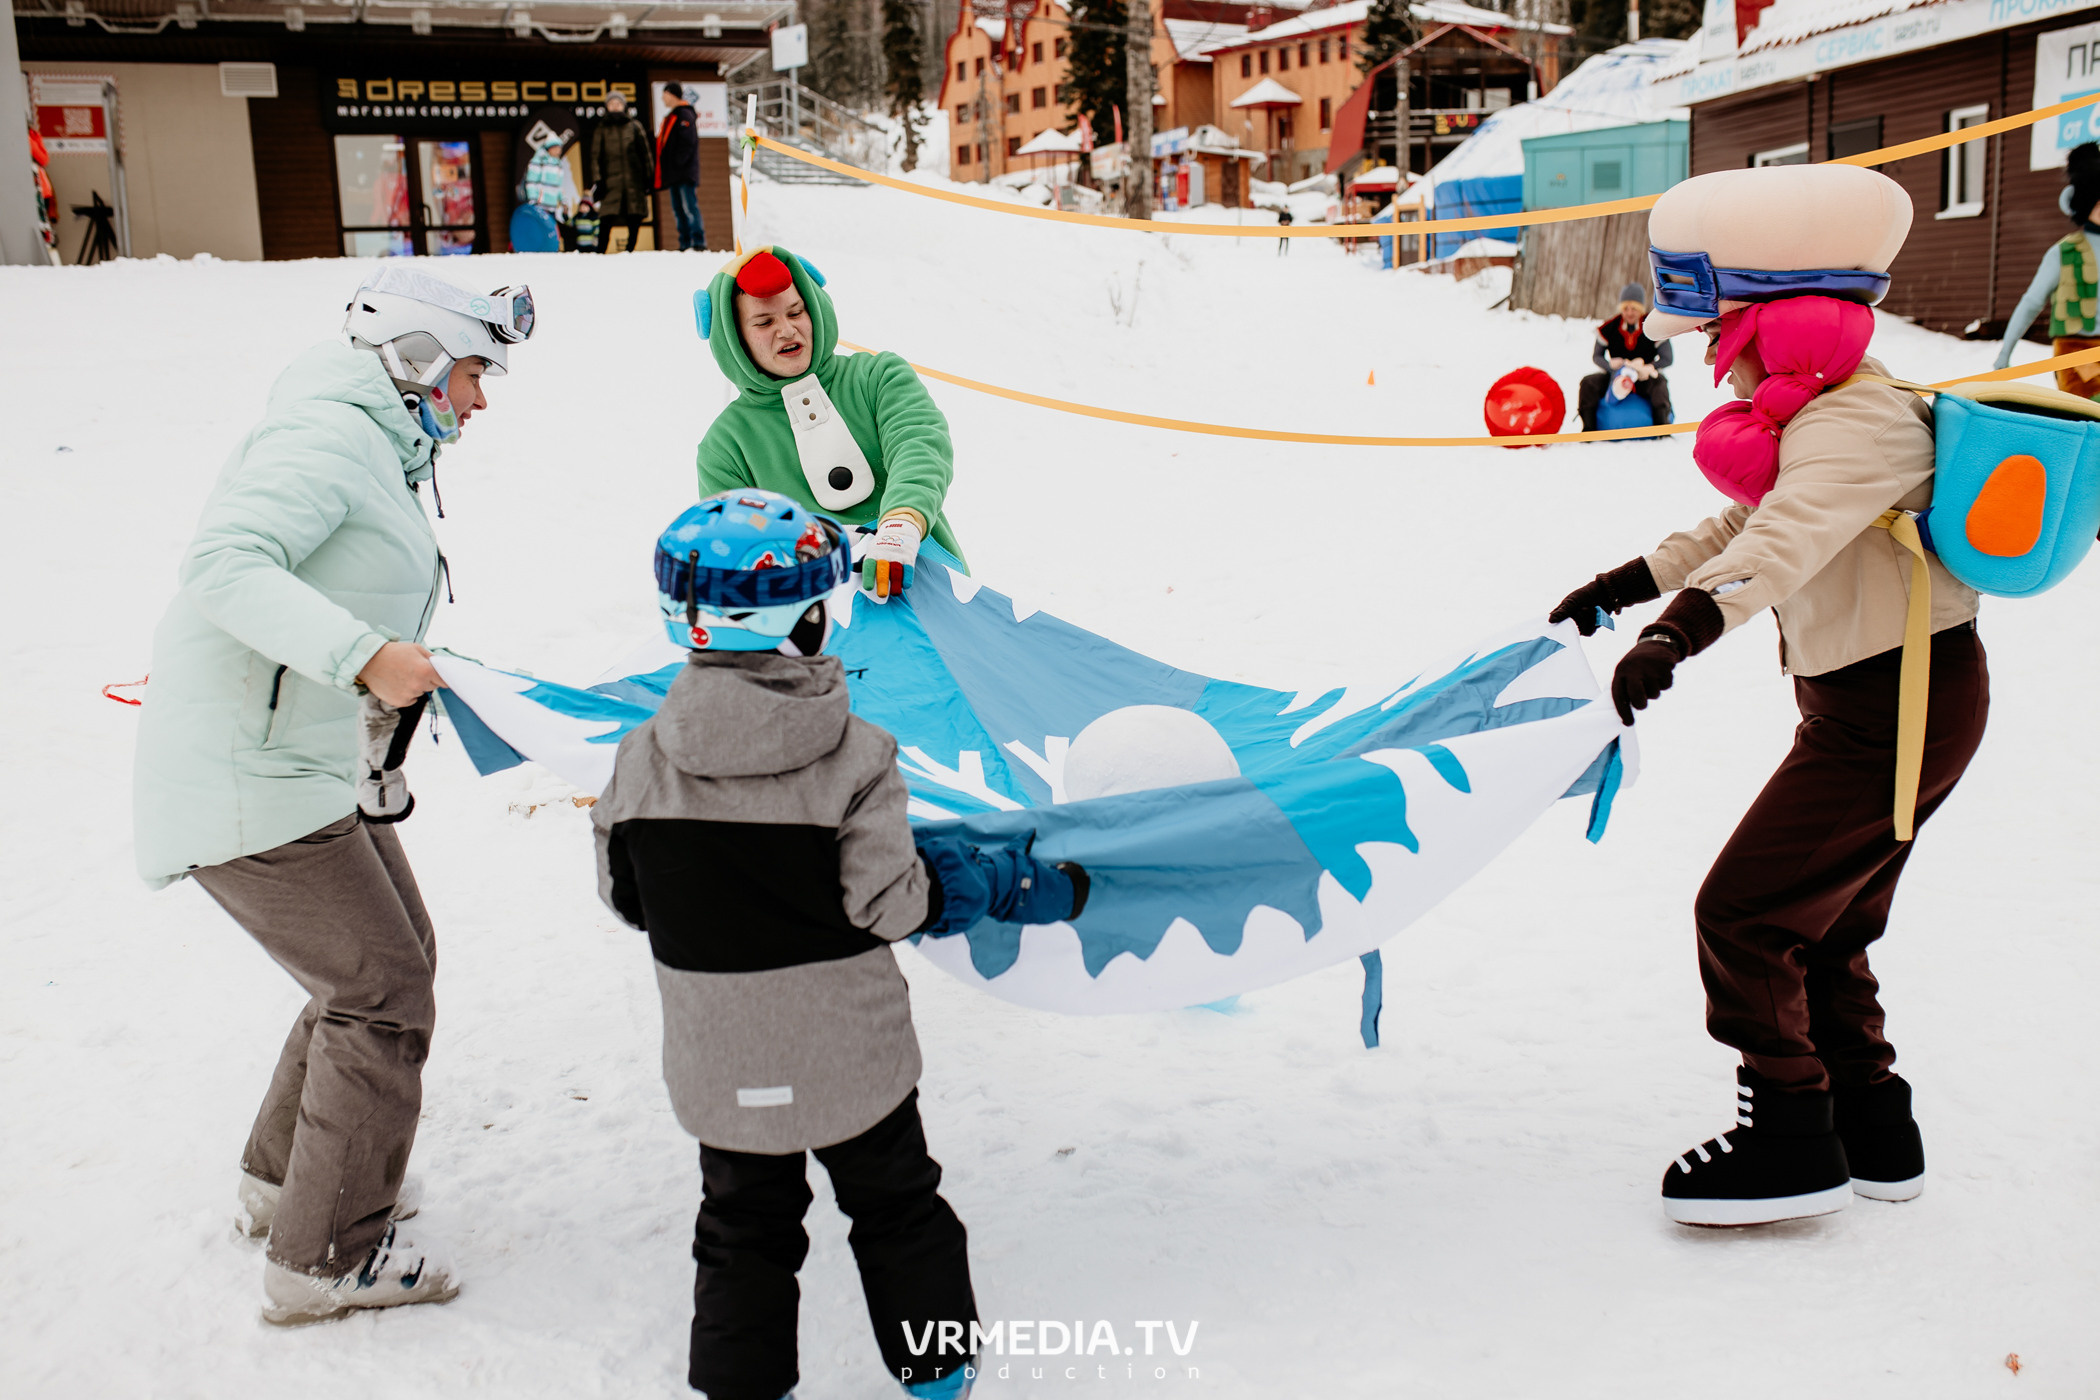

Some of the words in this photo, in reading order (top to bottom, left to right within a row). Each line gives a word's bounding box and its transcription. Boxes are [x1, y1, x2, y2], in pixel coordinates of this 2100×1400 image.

[1815, 26, 1884, 63] СЕРВИС
[1680, 68, 1733, 99] ПРОКАТ
[336, 105, 417, 117] магазин
[420, 104, 529, 120] спортивной
